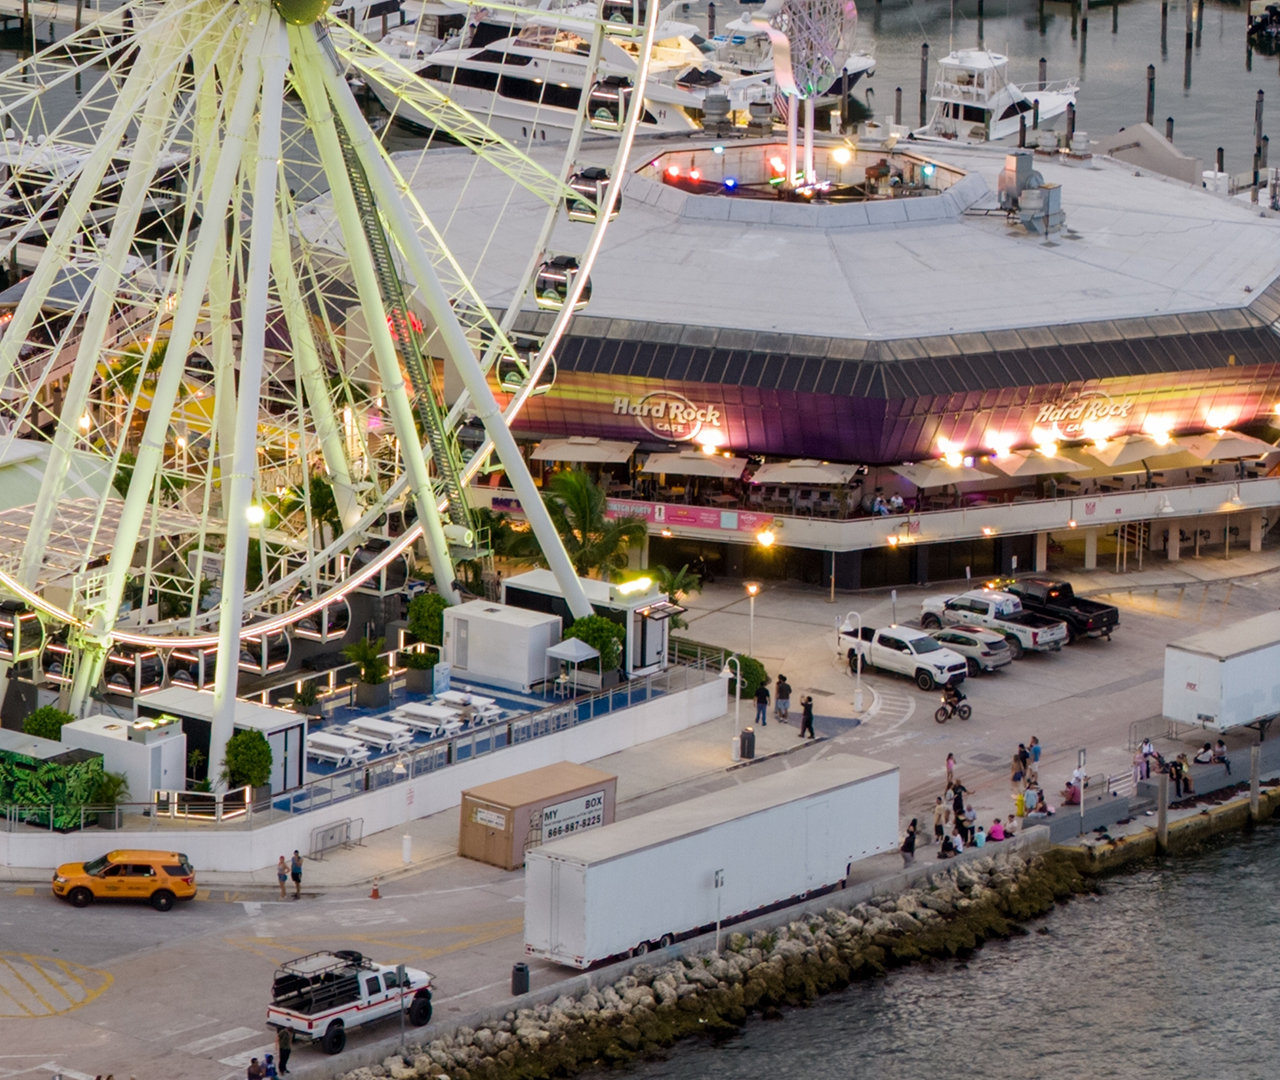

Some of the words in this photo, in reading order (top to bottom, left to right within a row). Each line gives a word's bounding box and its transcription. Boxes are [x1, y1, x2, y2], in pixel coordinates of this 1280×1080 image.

[613, 397, 666, 419] Hard
[668, 402, 721, 426] Rock
[1035, 400, 1088, 423] Hard
[1085, 398, 1133, 421] Rock
[656, 422, 685, 433] CAFE
[544, 808, 558, 822] MY
[585, 796, 602, 810] BOX
[547, 814, 602, 839] 866-887-8225
